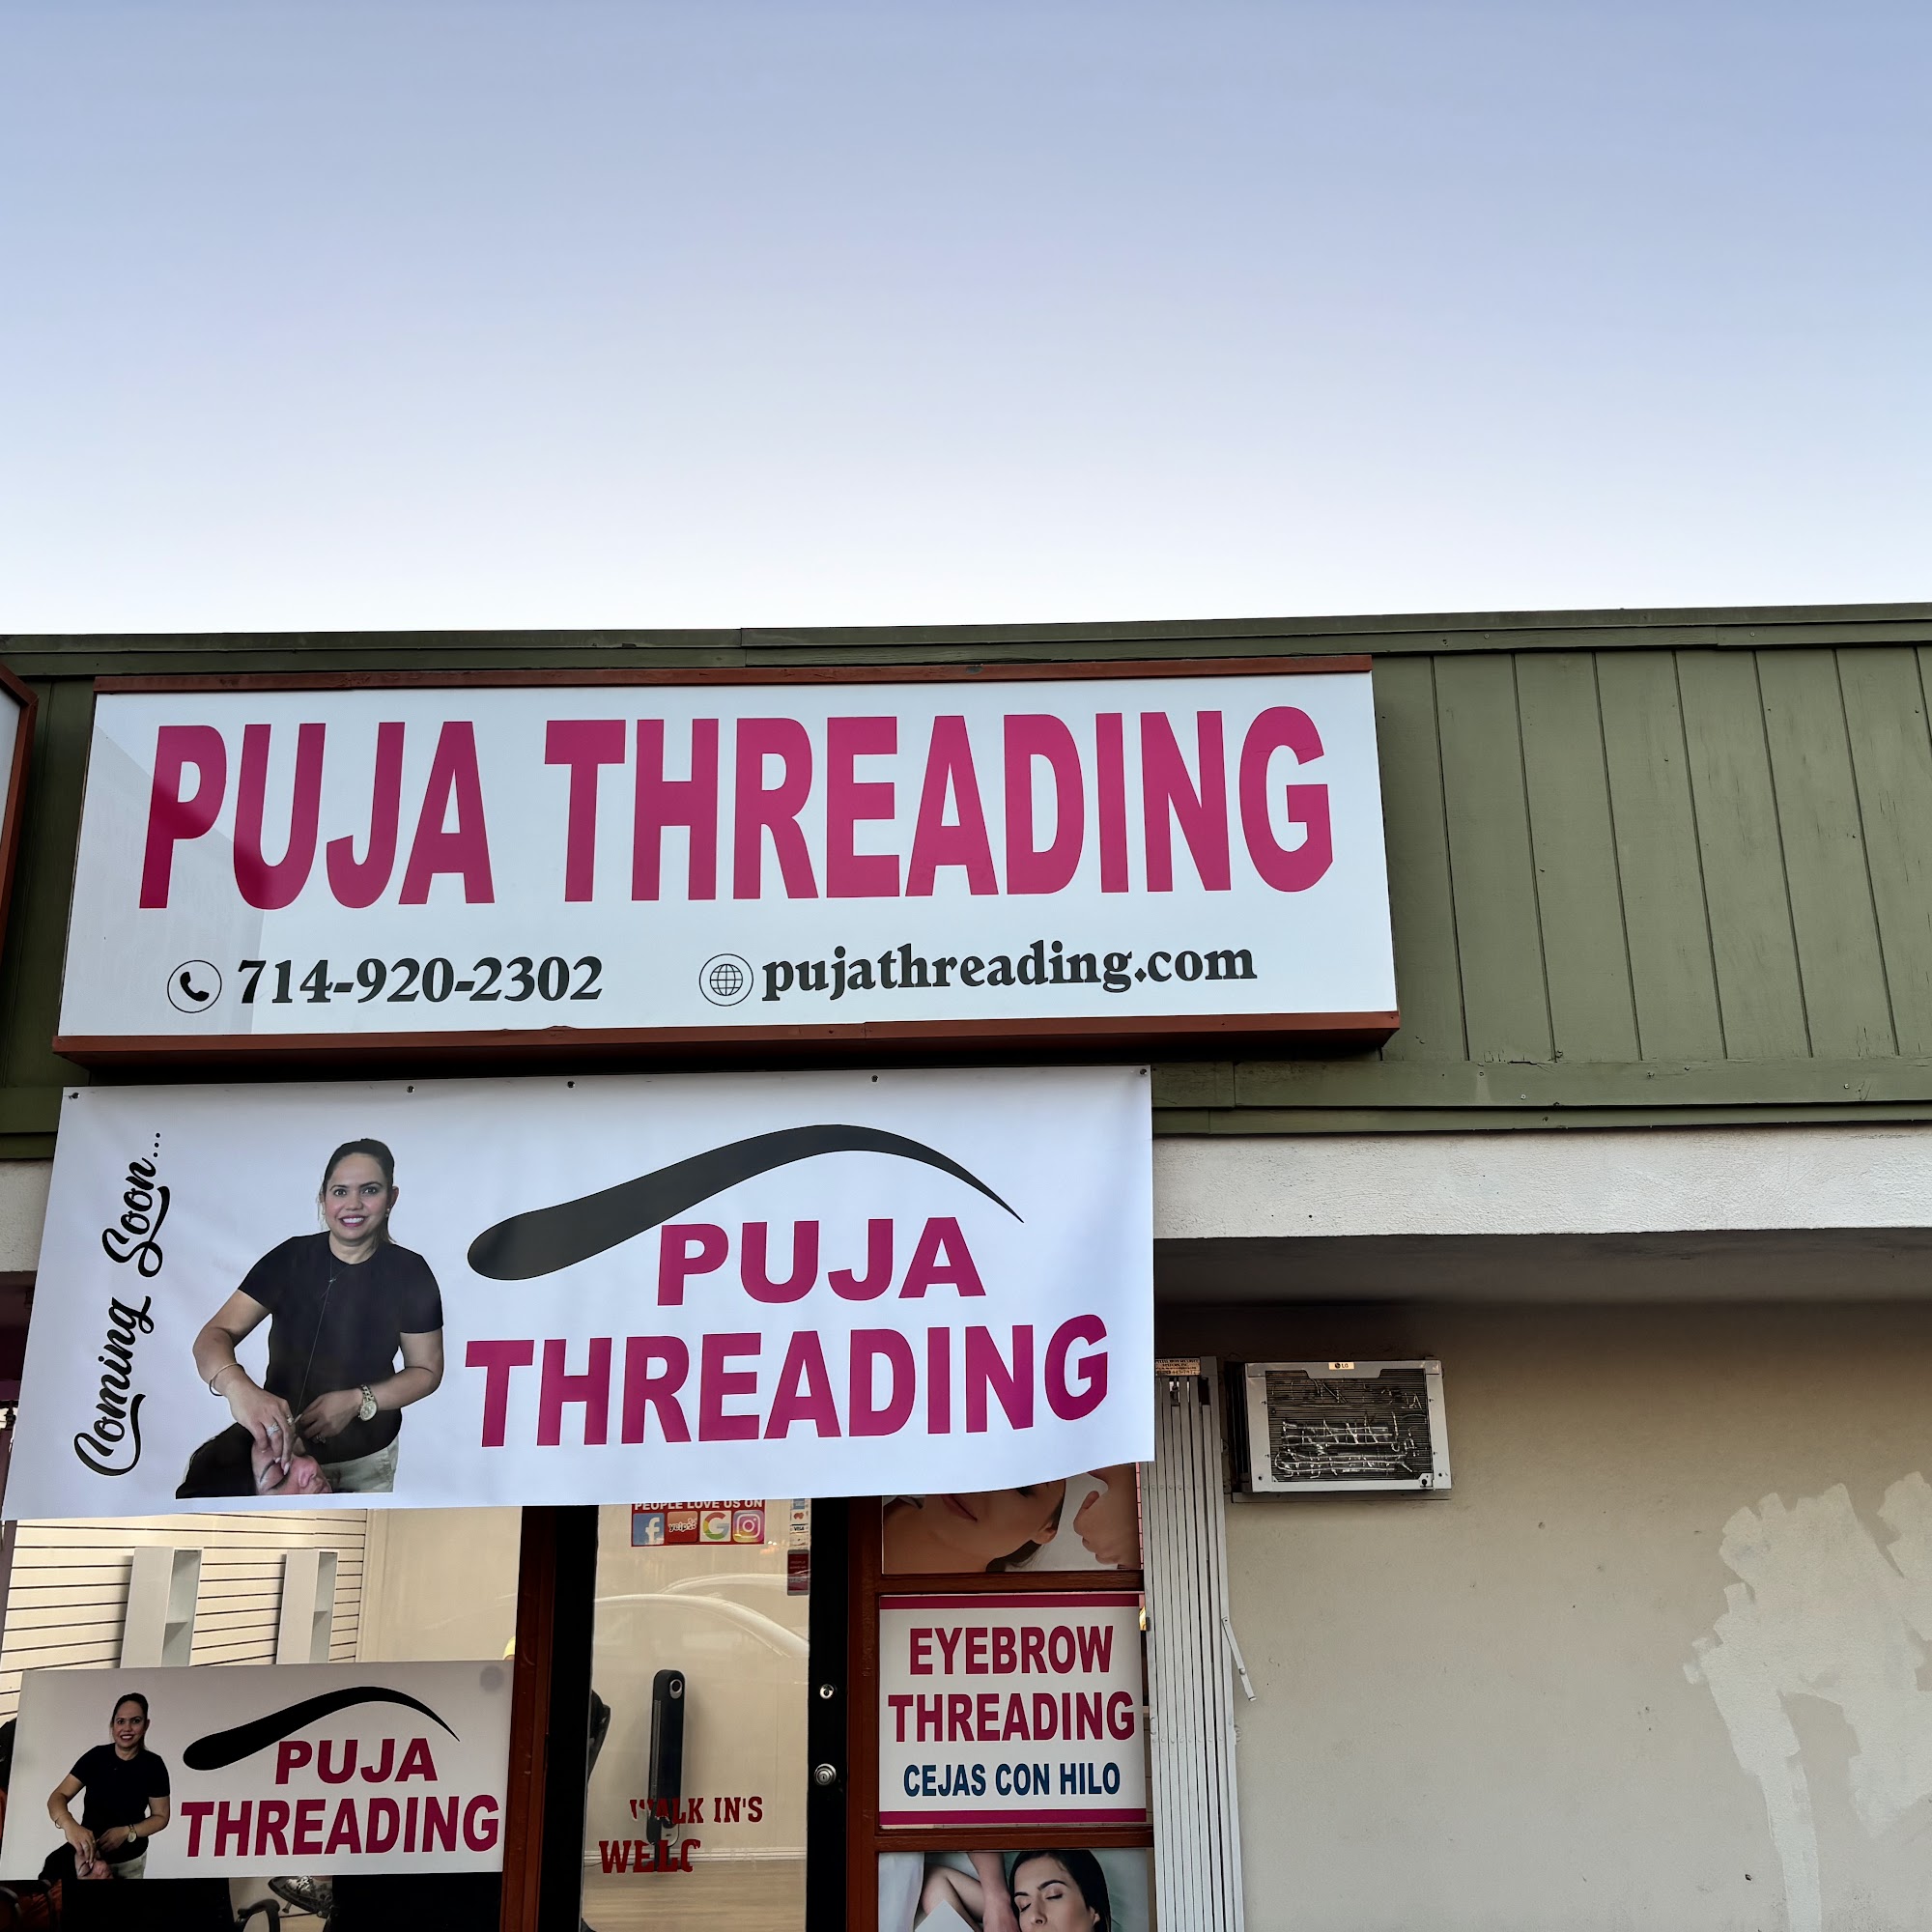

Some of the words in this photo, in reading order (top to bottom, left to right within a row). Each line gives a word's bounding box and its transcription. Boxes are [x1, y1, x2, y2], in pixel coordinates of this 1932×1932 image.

[139, 722, 495, 910] PUJA
[545, 707, 1333, 903] THREADING
[238, 955, 603, 1004] 714-920-2302
[761, 939, 1258, 1002] pujathreading.com
[658, 1217, 986, 1306] PUJA
[73, 1296, 155, 1477] Coming
[465, 1314, 1109, 1447] THREADING
[634, 1502, 684, 1511] PEOPLE
[744, 1499, 763, 1508] ON
[909, 1625, 1114, 1675] EYEBROW
[888, 1691, 1135, 1743] THREADING
[275, 1738, 438, 1785] PUJA
[904, 1764, 986, 1797] CEJAS
[995, 1764, 1050, 1797] CON
[1060, 1762, 1121, 1796] HILO
[181, 1794, 499, 1858] THREADING
[714, 1797, 763, 1824] IN'S
